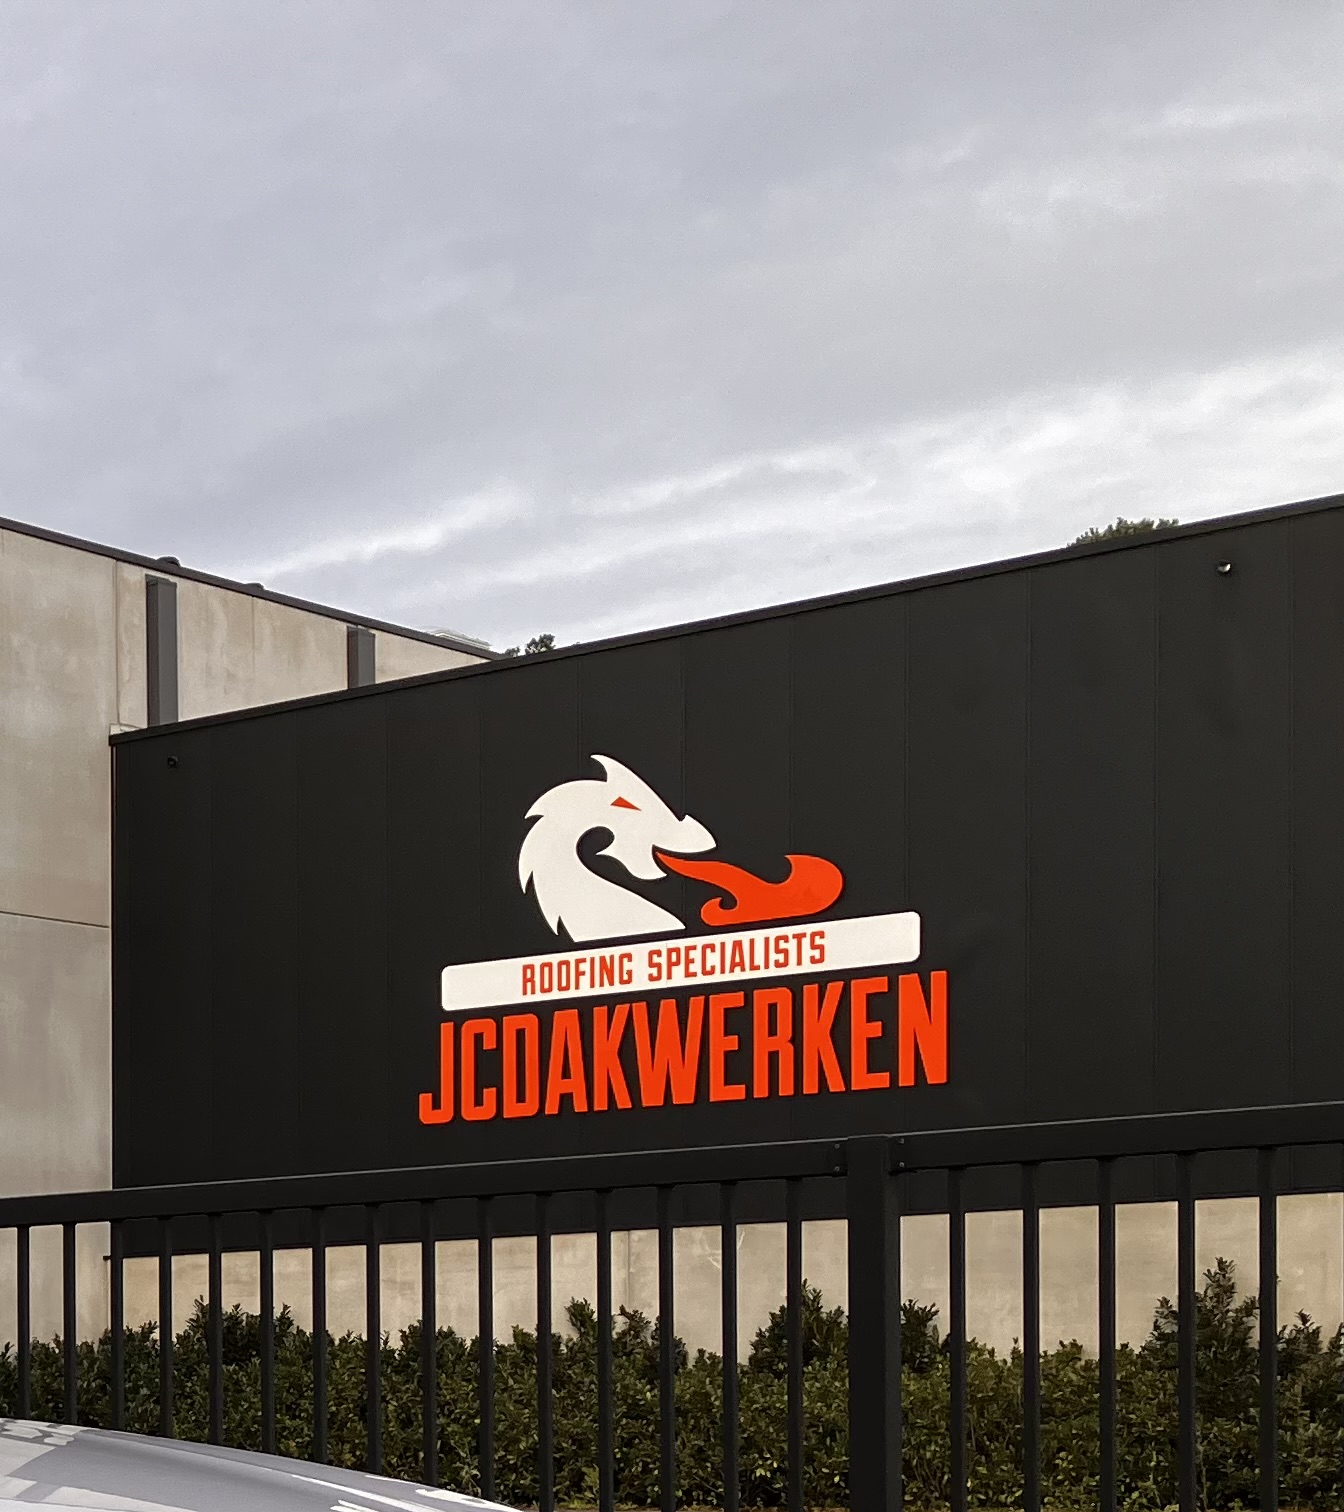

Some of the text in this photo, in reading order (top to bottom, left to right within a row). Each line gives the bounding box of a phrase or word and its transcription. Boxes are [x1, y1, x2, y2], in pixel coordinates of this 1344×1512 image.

[521, 930, 827, 997] ROOFING SPECIALISTS
[418, 970, 948, 1125] JCDAKWERKEN
